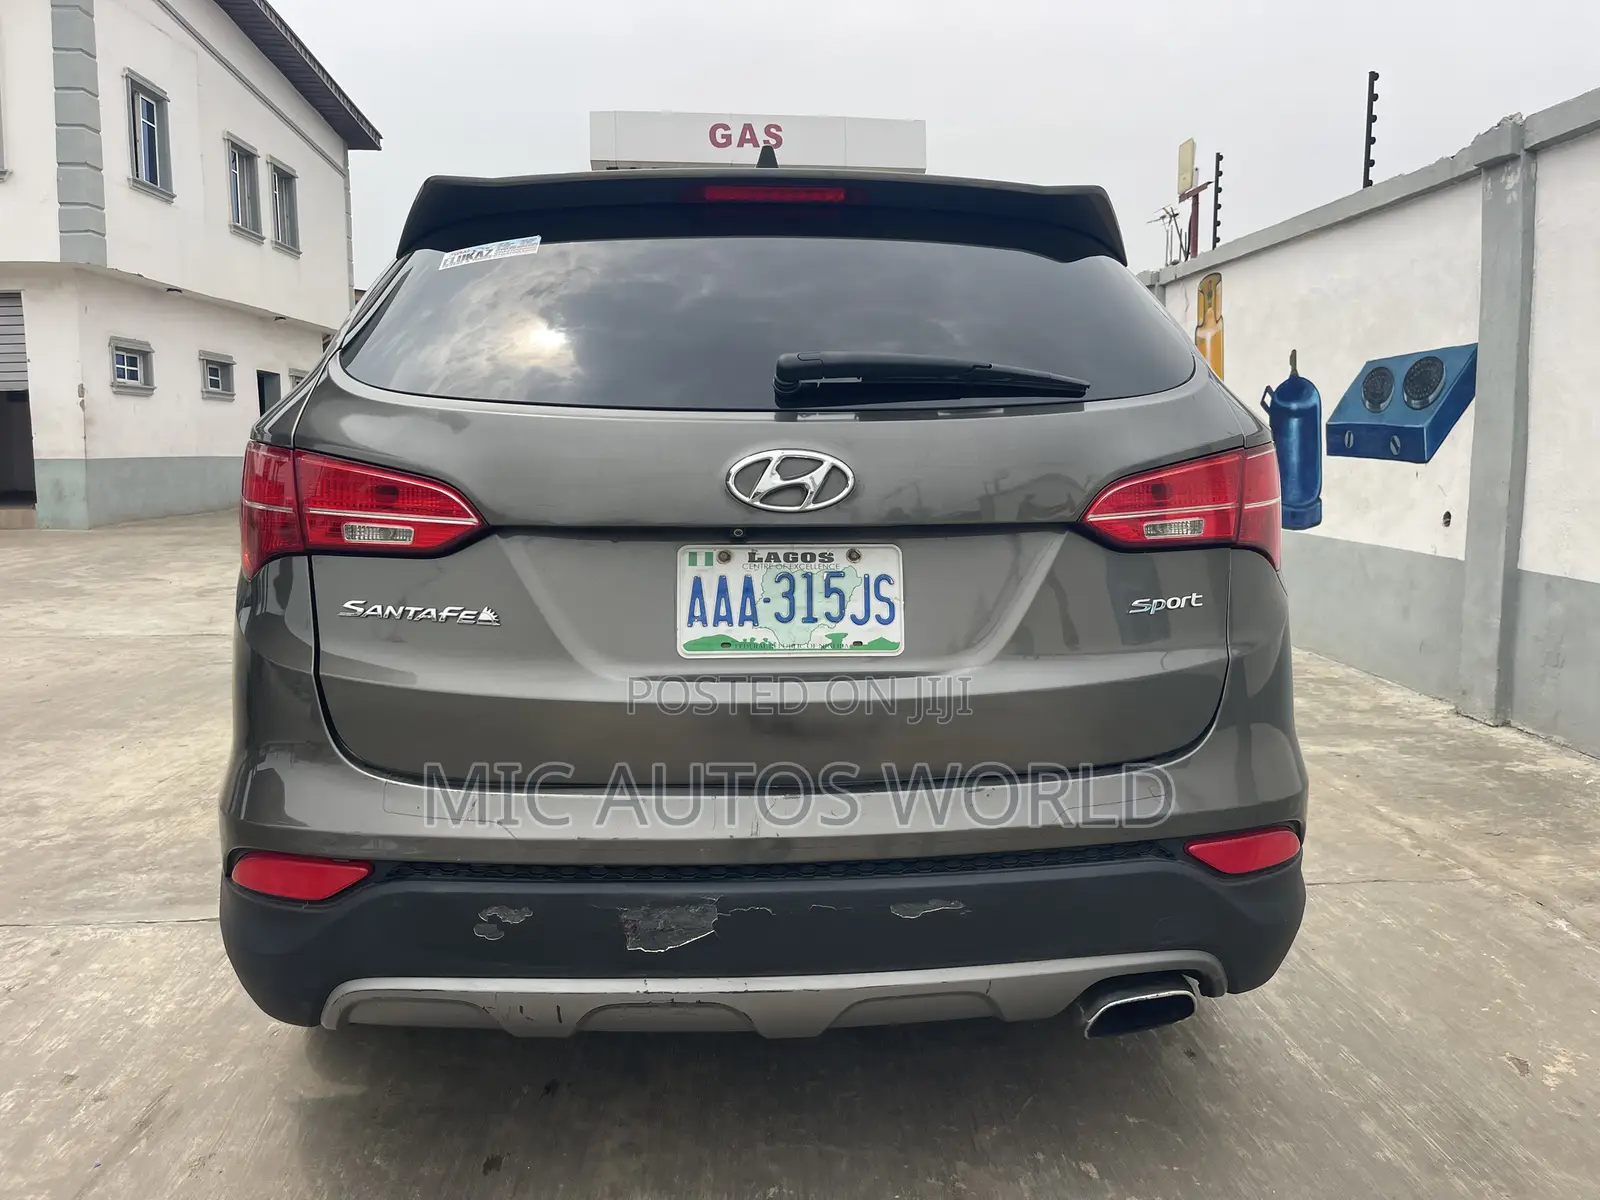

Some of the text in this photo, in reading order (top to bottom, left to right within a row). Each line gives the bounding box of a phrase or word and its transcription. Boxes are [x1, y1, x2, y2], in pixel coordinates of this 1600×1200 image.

[709, 123, 783, 149] GAS
[747, 551, 835, 563] LAGOS
[1129, 593, 1203, 614] Sport
